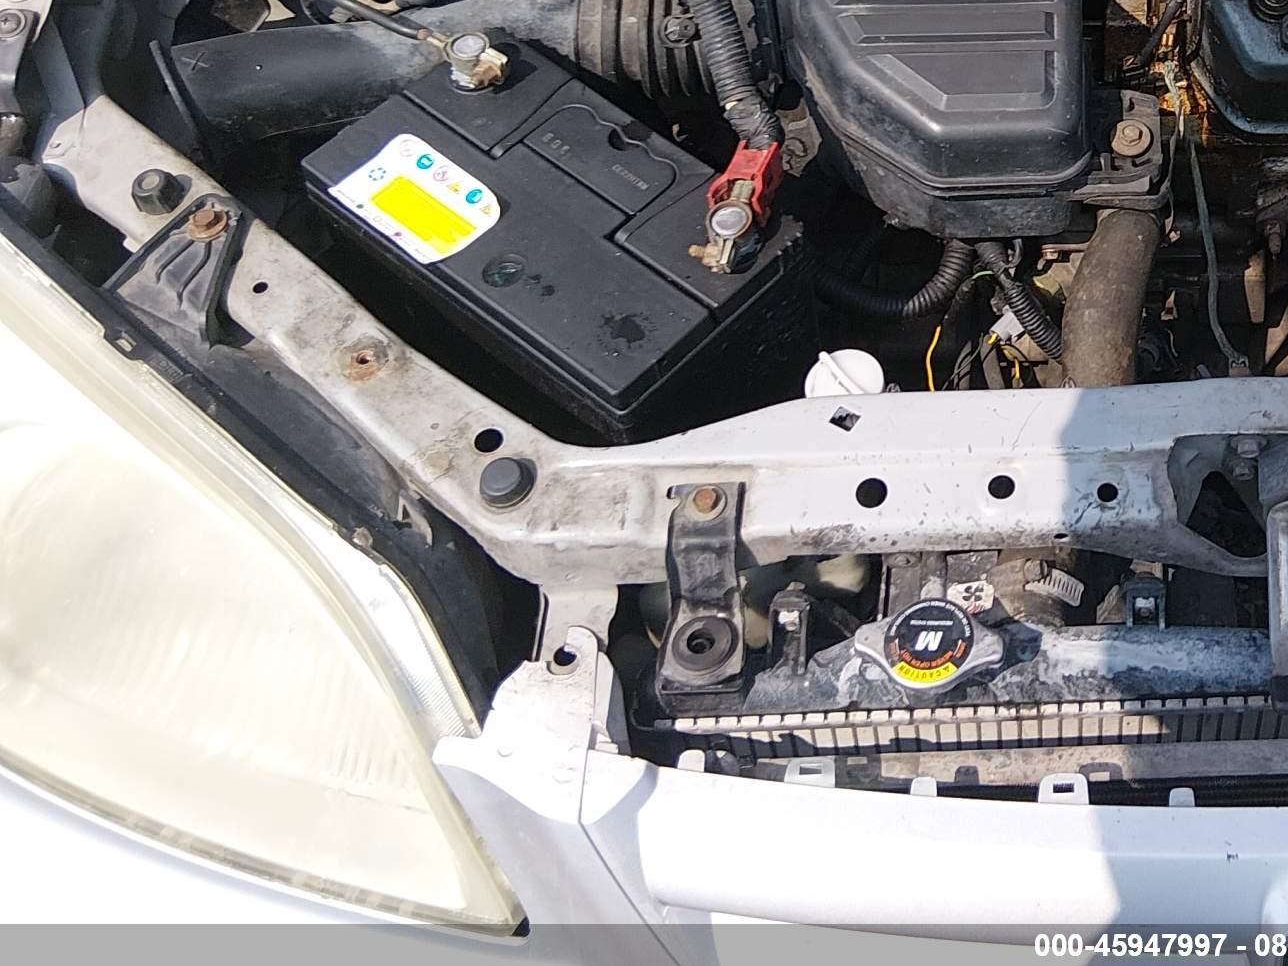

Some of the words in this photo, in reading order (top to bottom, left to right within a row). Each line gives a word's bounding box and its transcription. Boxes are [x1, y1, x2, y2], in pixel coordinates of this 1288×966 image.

[914, 631, 943, 651] M
[910, 658, 930, 668] OPEN
[899, 665, 941, 678] CAUTION
